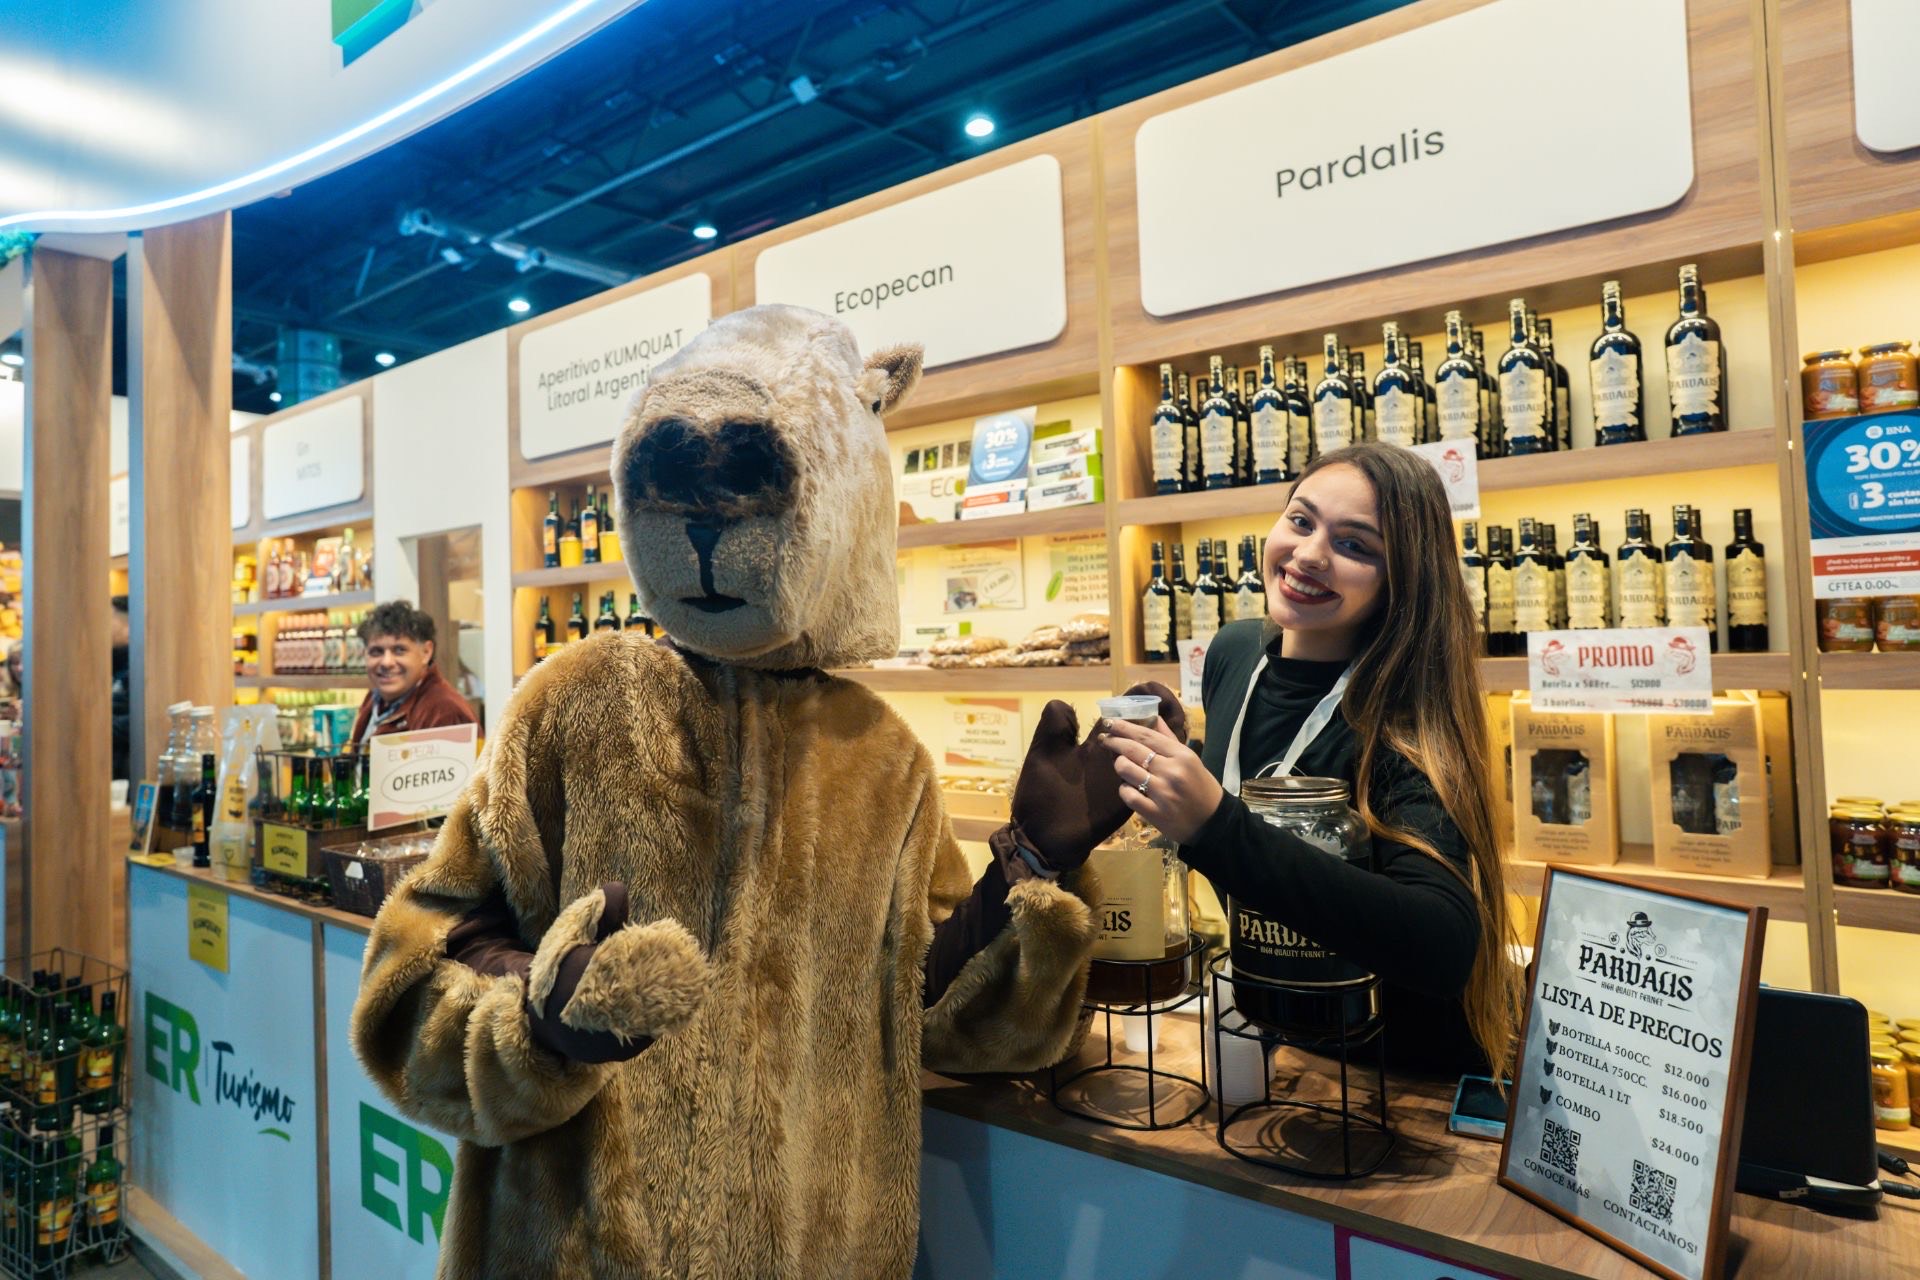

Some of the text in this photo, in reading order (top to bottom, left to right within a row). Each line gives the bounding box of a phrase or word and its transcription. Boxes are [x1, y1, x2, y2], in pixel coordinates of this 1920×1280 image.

[1276, 128, 1445, 198] Pardalis
[835, 264, 953, 313] Ecopecan
[538, 329, 683, 392] Aperitivo KUMQUAT
[548, 365, 651, 411] Litoral Argenti
[1886, 425, 1911, 435] BNA
[1861, 482, 1886, 508] 3
[1828, 581, 1862, 592] CFTEA
[1578, 644, 1655, 669] PROMO
[392, 767, 455, 791] OFERTAS
[1578, 944, 1693, 1002] PARDALIS
[1601, 981, 1615, 991] HIGH
[1615, 984, 1639, 998] QUALITY
[1541, 983, 1723, 1058] LISTA DE PRECIOS
[145, 990, 296, 1124] ER Turismo
[1558, 1045, 1707, 1110] BOTELLA 750CC. $16.000
[1561, 1025, 1710, 1088] BOTELLA 500CC. $12.000
[1555, 1066, 1704, 1135] BOTELLA 1 LT $18.500
[1556, 1095, 1700, 1167] COMBO $24.000
[359, 1100, 455, 1248] ER
[1602, 1198, 1698, 1257] CONTACTANOS!
